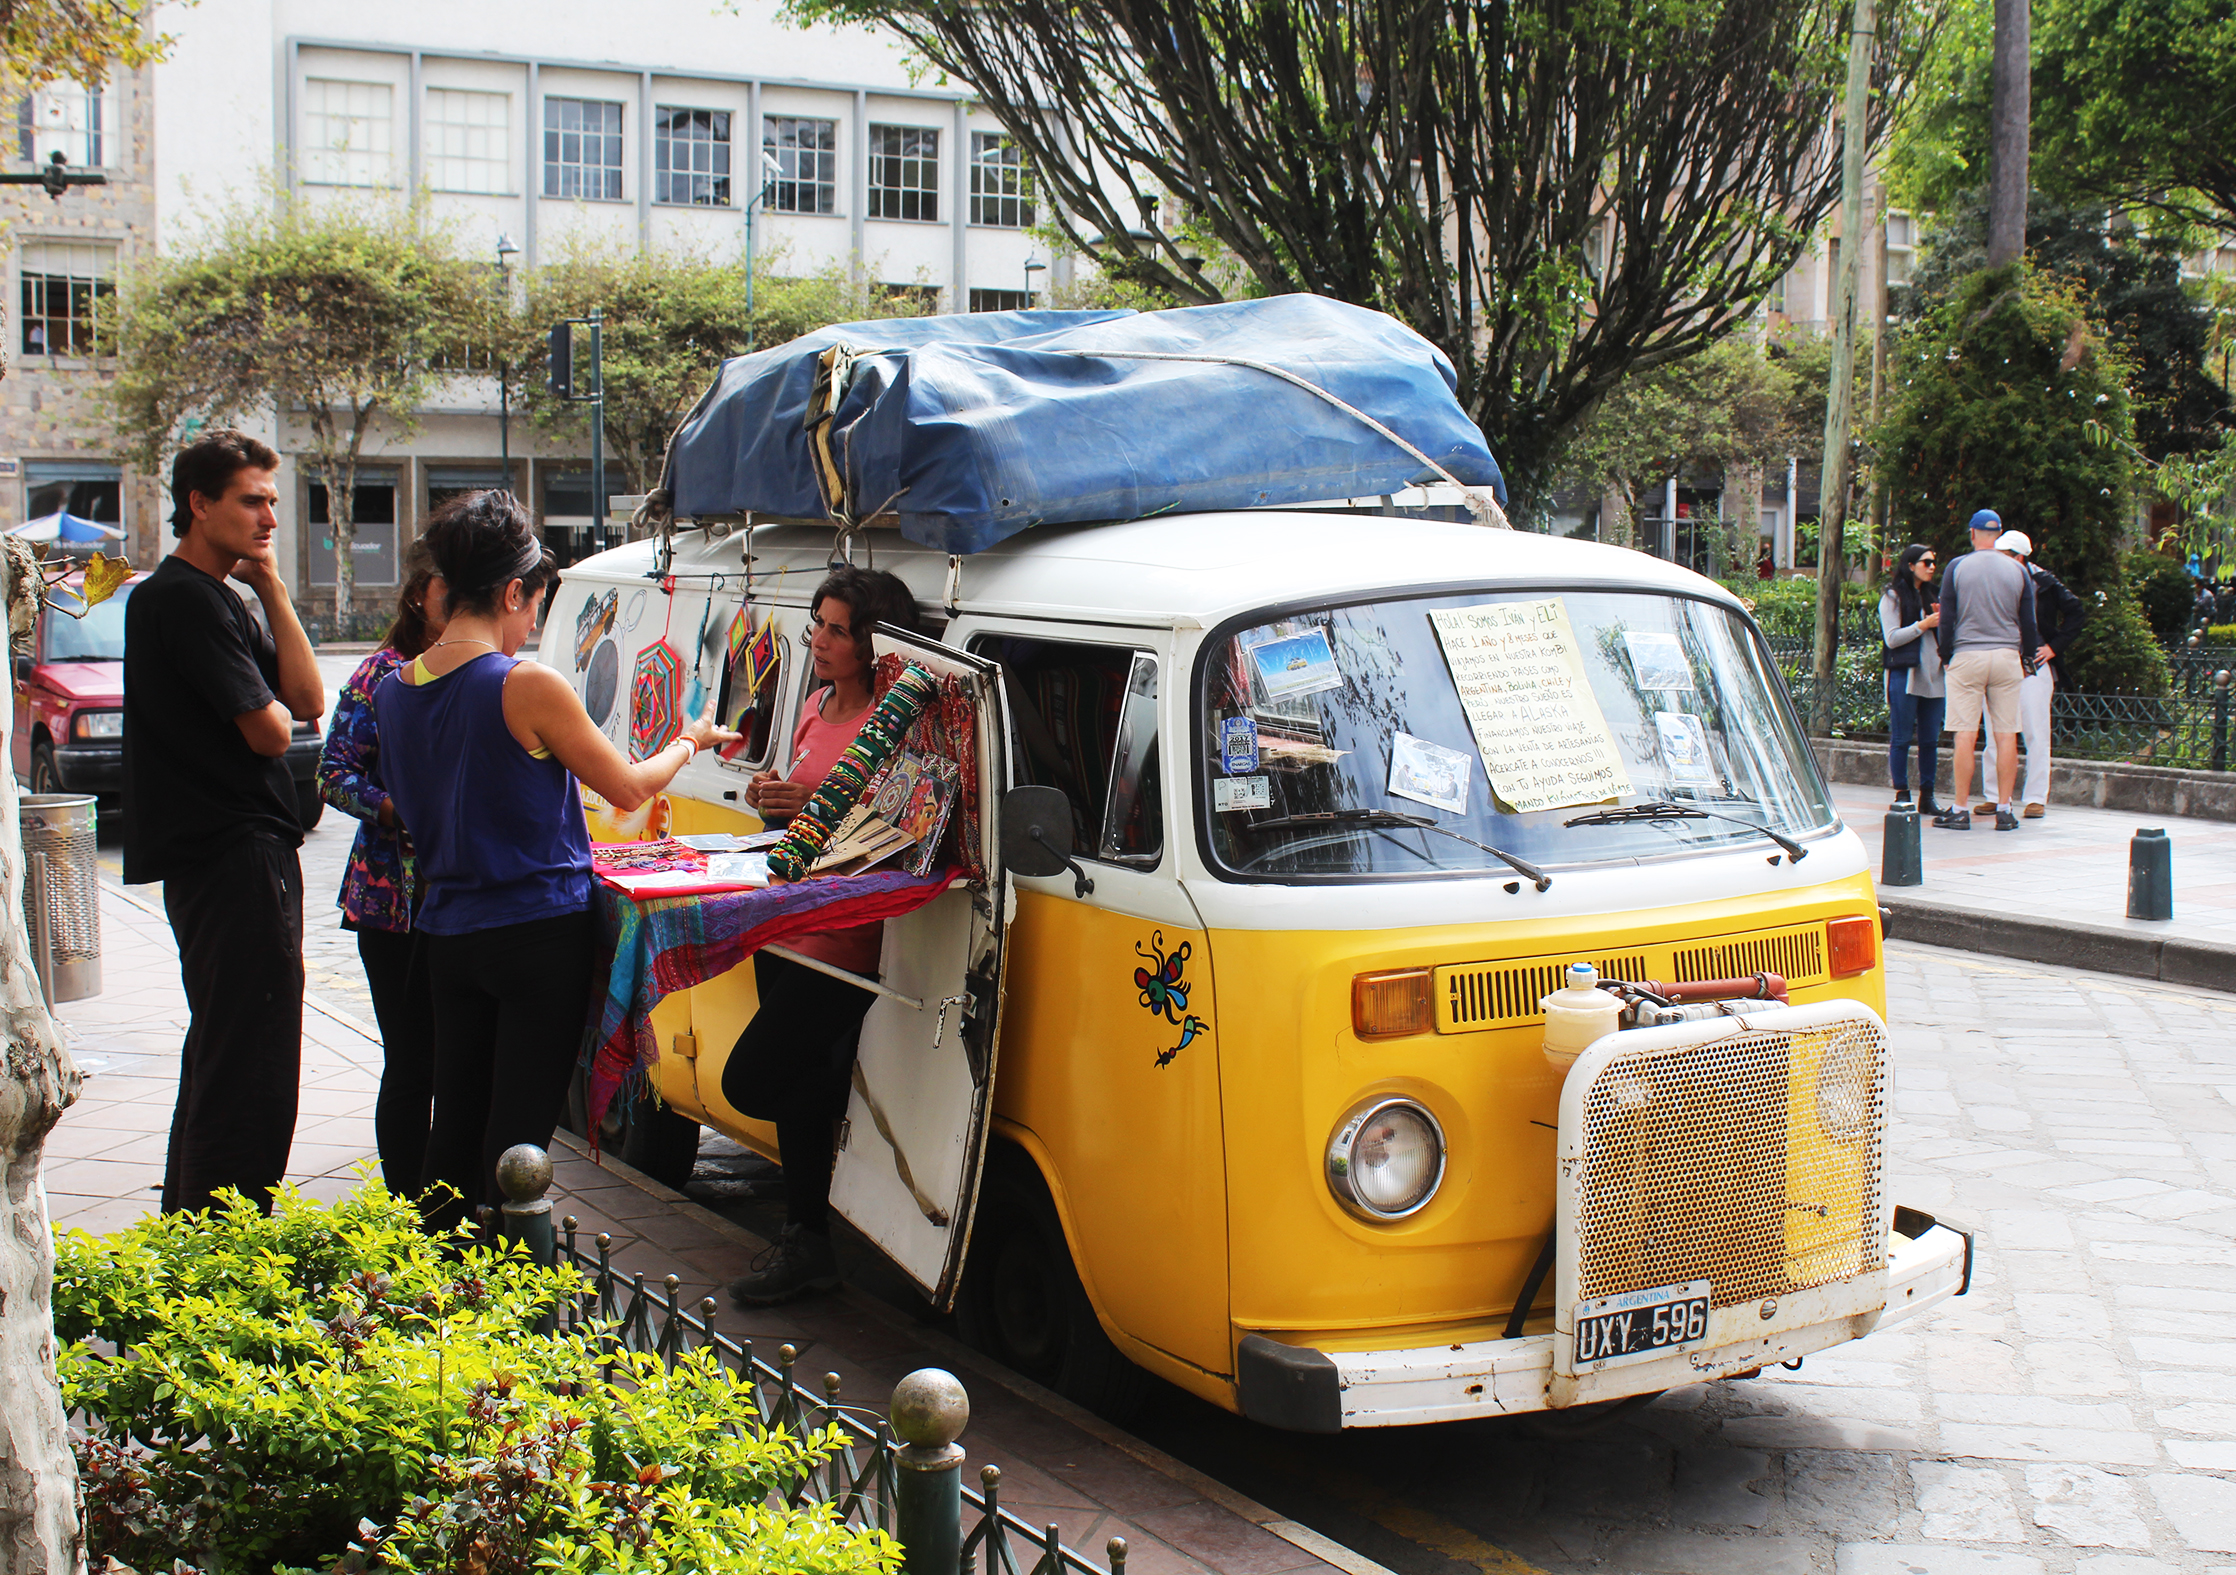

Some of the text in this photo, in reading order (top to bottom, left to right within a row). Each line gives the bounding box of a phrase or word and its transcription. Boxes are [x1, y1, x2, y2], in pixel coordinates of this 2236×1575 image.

[1444, 636, 1468, 651] HACE
[1471, 635, 1479, 649] 1
[1481, 635, 1498, 648] AÑO
[1507, 632, 1515, 644] 8
[1515, 633, 1539, 646] MESES
[1542, 630, 1559, 640] QUE
[1489, 653, 1500, 662] EN
[1505, 649, 1538, 661] NUESTRA
[1541, 665, 1560, 676] COMO
[1531, 689, 1559, 702] SUEÑO
[1562, 689, 1574, 699] ES
[1471, 711, 1504, 722] LLEGAR
[1512, 710, 1519, 719] A
[1532, 724, 1563, 735] NUESTRO
[1483, 746, 1500, 755] CON
[1505, 743, 1516, 754] LA
[1518, 740, 1541, 753] VENTA
[1544, 742, 1555, 751] DE
[1489, 759, 1529, 775] ACERCATE
[1531, 759, 1539, 770] A
[1497, 783, 1516, 794] CON
[1533, 774, 1565, 791] AYUDA
[1616, 1290, 1670, 1308] ARGENTINA
[1580, 1301, 1706, 1360] UXY 596
